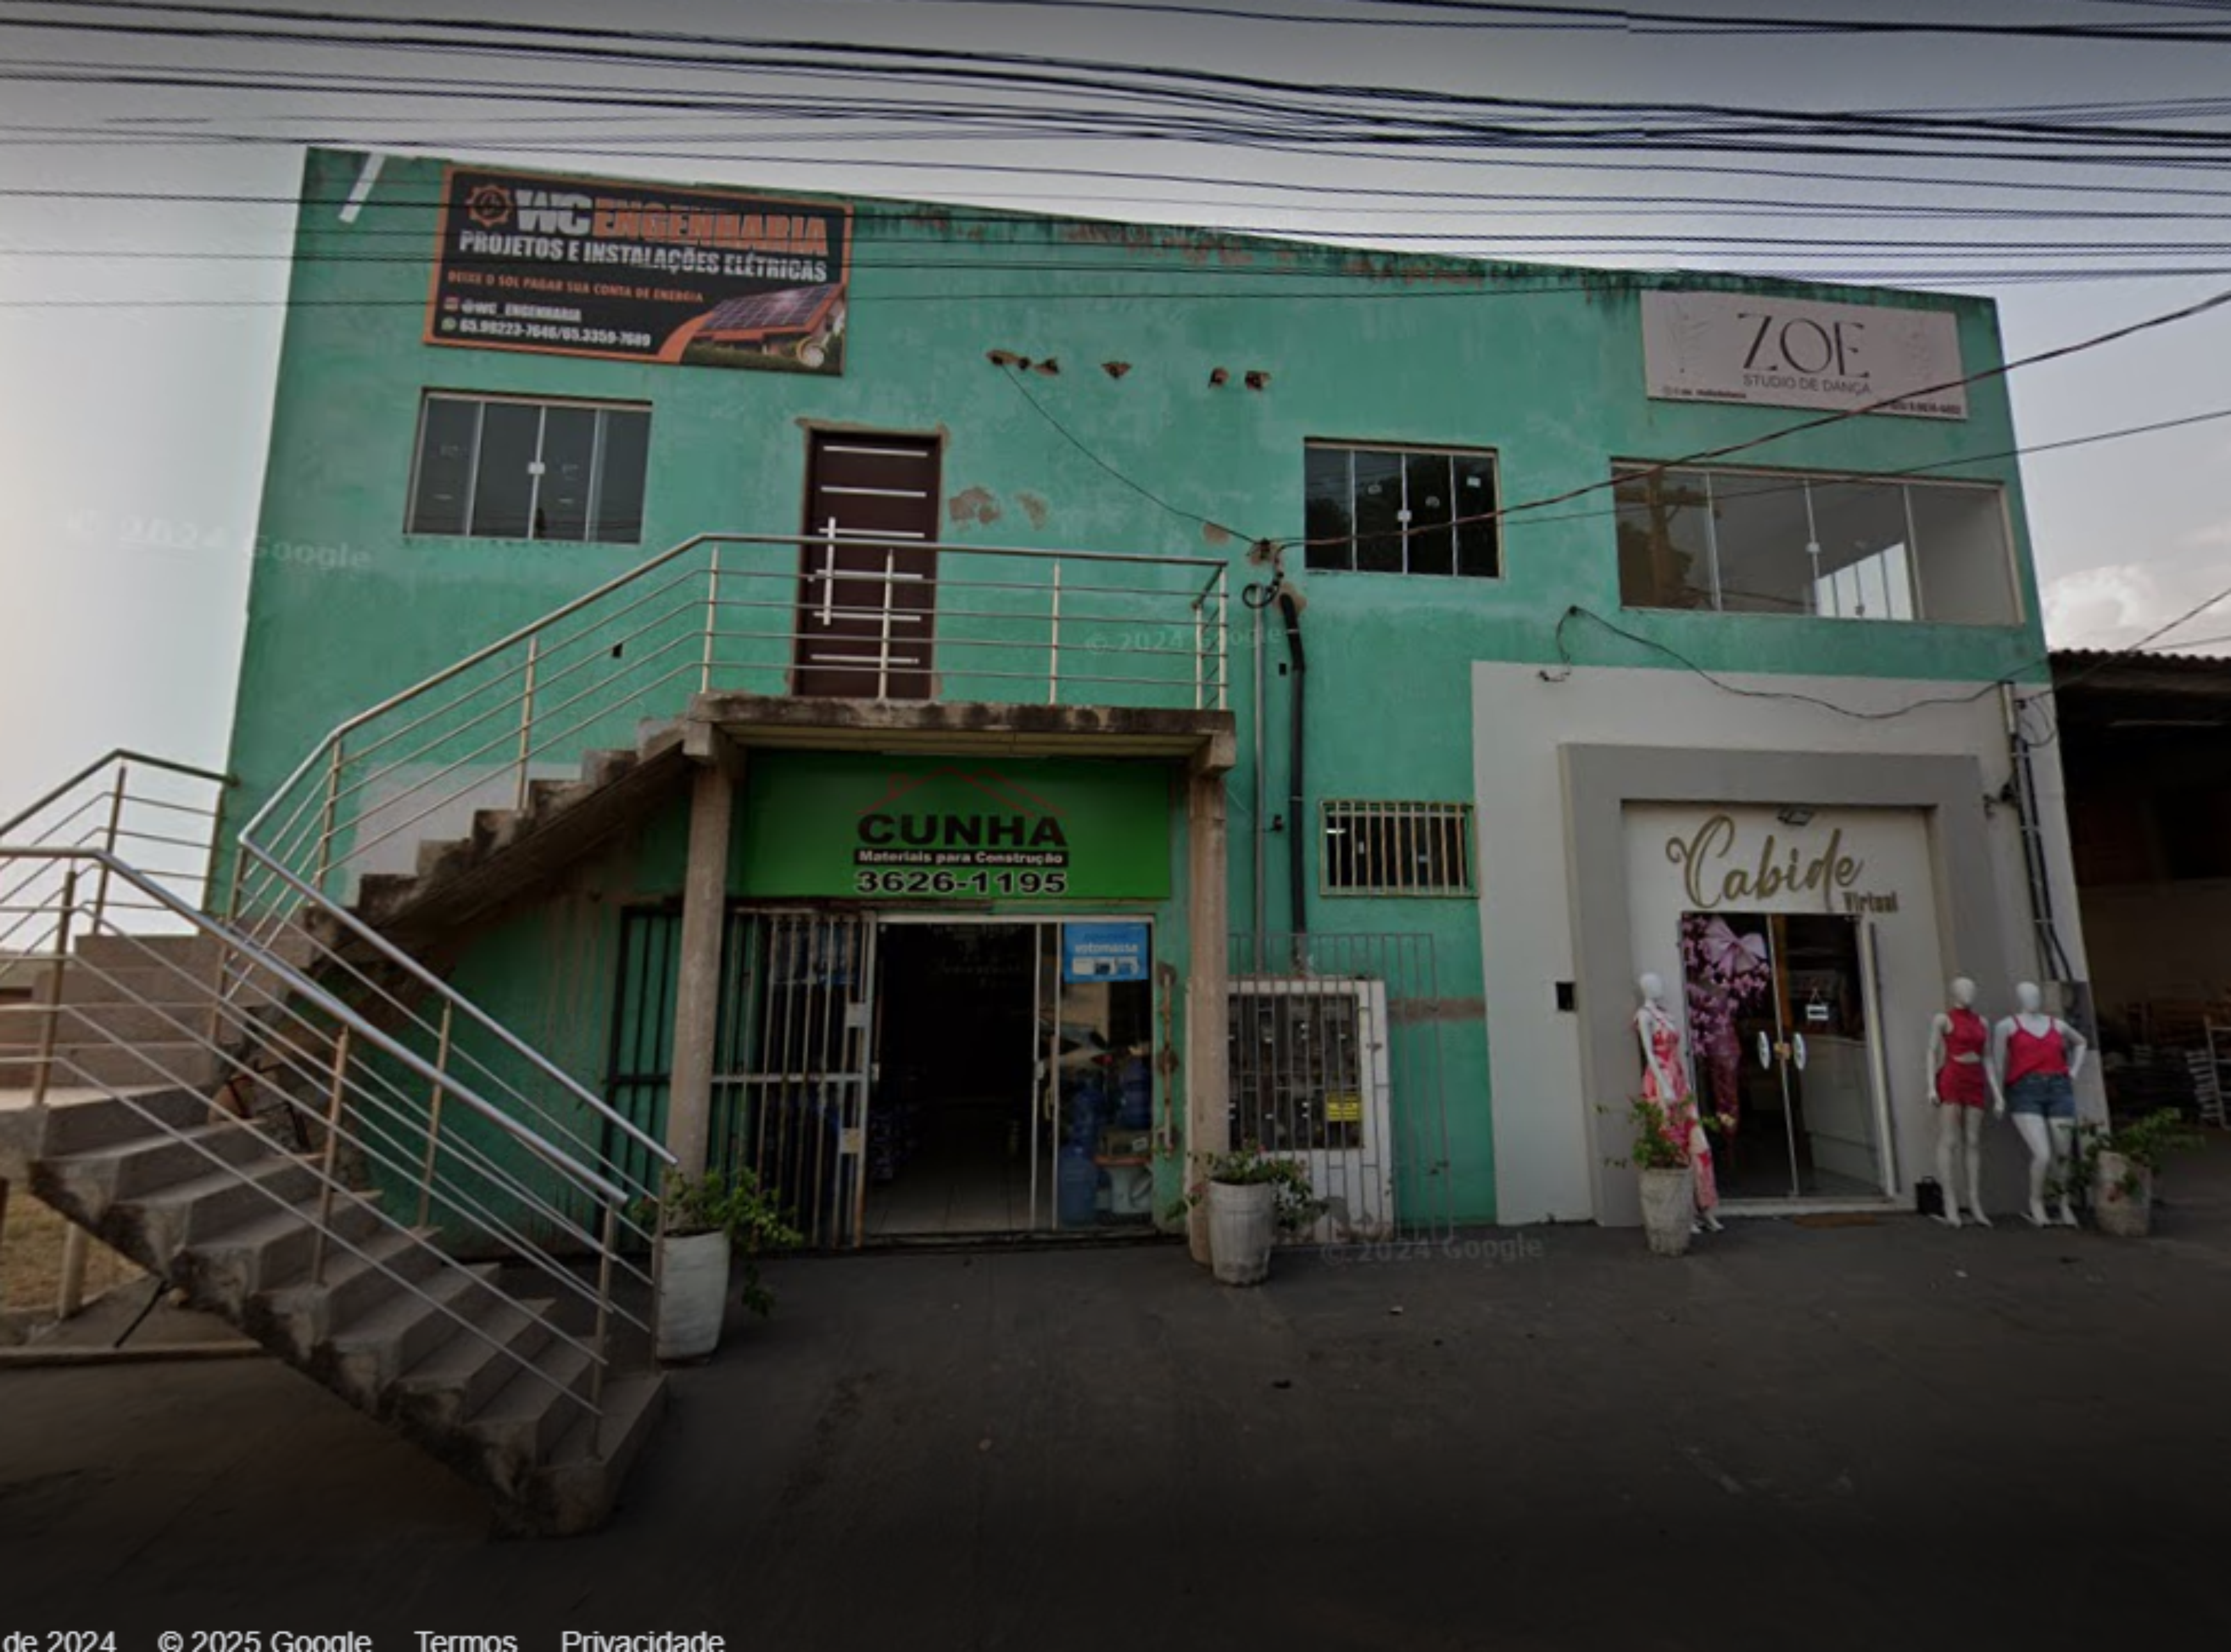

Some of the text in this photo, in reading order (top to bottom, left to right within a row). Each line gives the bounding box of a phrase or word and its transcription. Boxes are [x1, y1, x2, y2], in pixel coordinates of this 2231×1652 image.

[459, 230, 827, 283] PROJETOS E INSTALAÇÕES ELÉTRICAS
[498, 275, 520, 289] SOL
[523, 276, 565, 292] PAGAR
[566, 280, 590, 294] SUA
[594, 282, 632, 298] CONTA
[635, 286, 651, 300] DE
[654, 287, 704, 303] ENERGIA
[1737, 311, 1870, 378] ZOE
[1743, 373, 1872, 397] STUDIO DE DANÇA
[857, 813, 1068, 847] CUNHA
[858, 850, 1063, 866] Materiais para Construção
[1665, 813, 1864, 912] Cabide
[856, 870, 1067, 895] 3626-1195
